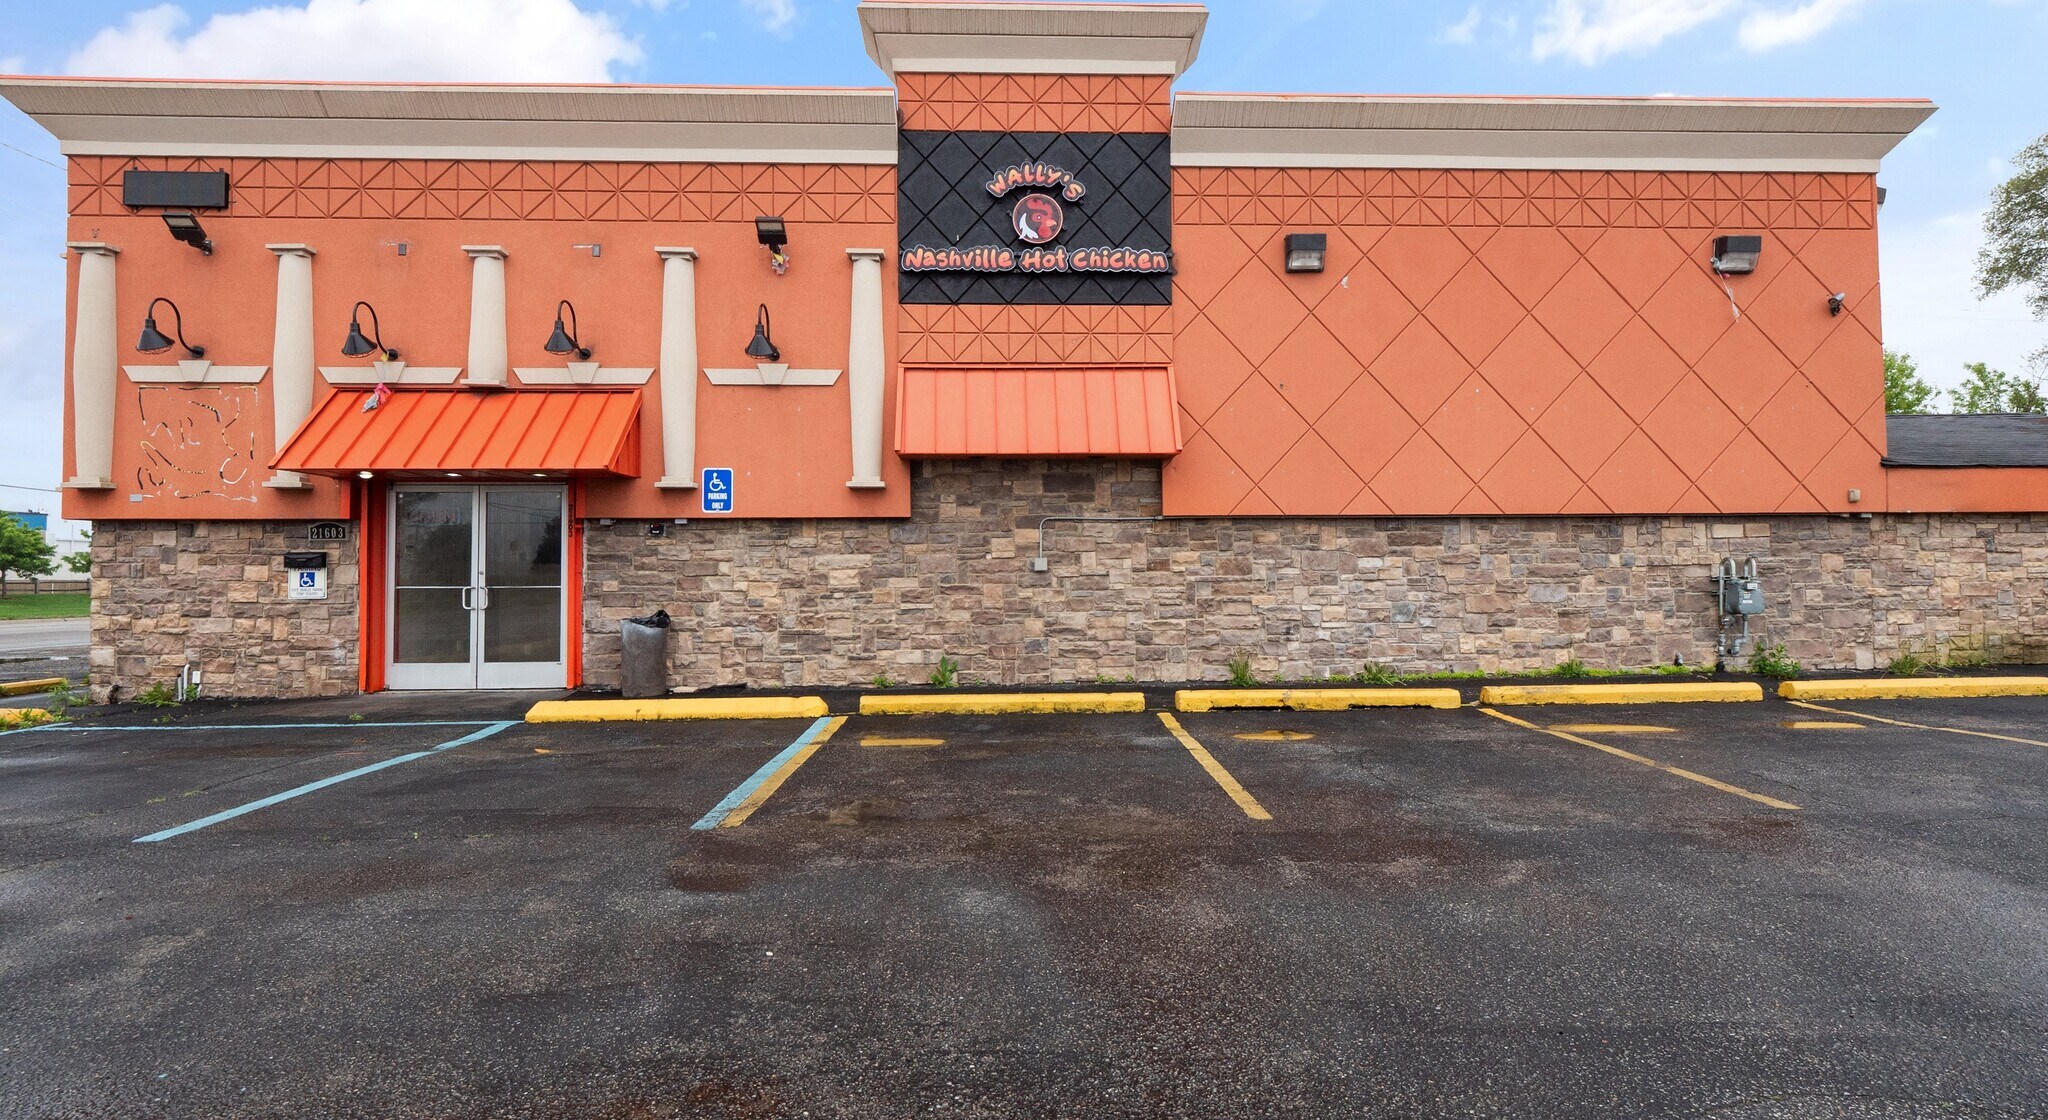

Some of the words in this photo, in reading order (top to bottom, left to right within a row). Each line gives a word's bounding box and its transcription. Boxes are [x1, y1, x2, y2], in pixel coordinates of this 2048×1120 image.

[987, 162, 1085, 200] WALLY'S
[903, 245, 1014, 271] Nashville
[1021, 246, 1068, 271] Hot
[1071, 247, 1168, 271] Chicken
[312, 528, 343, 538] 21603
